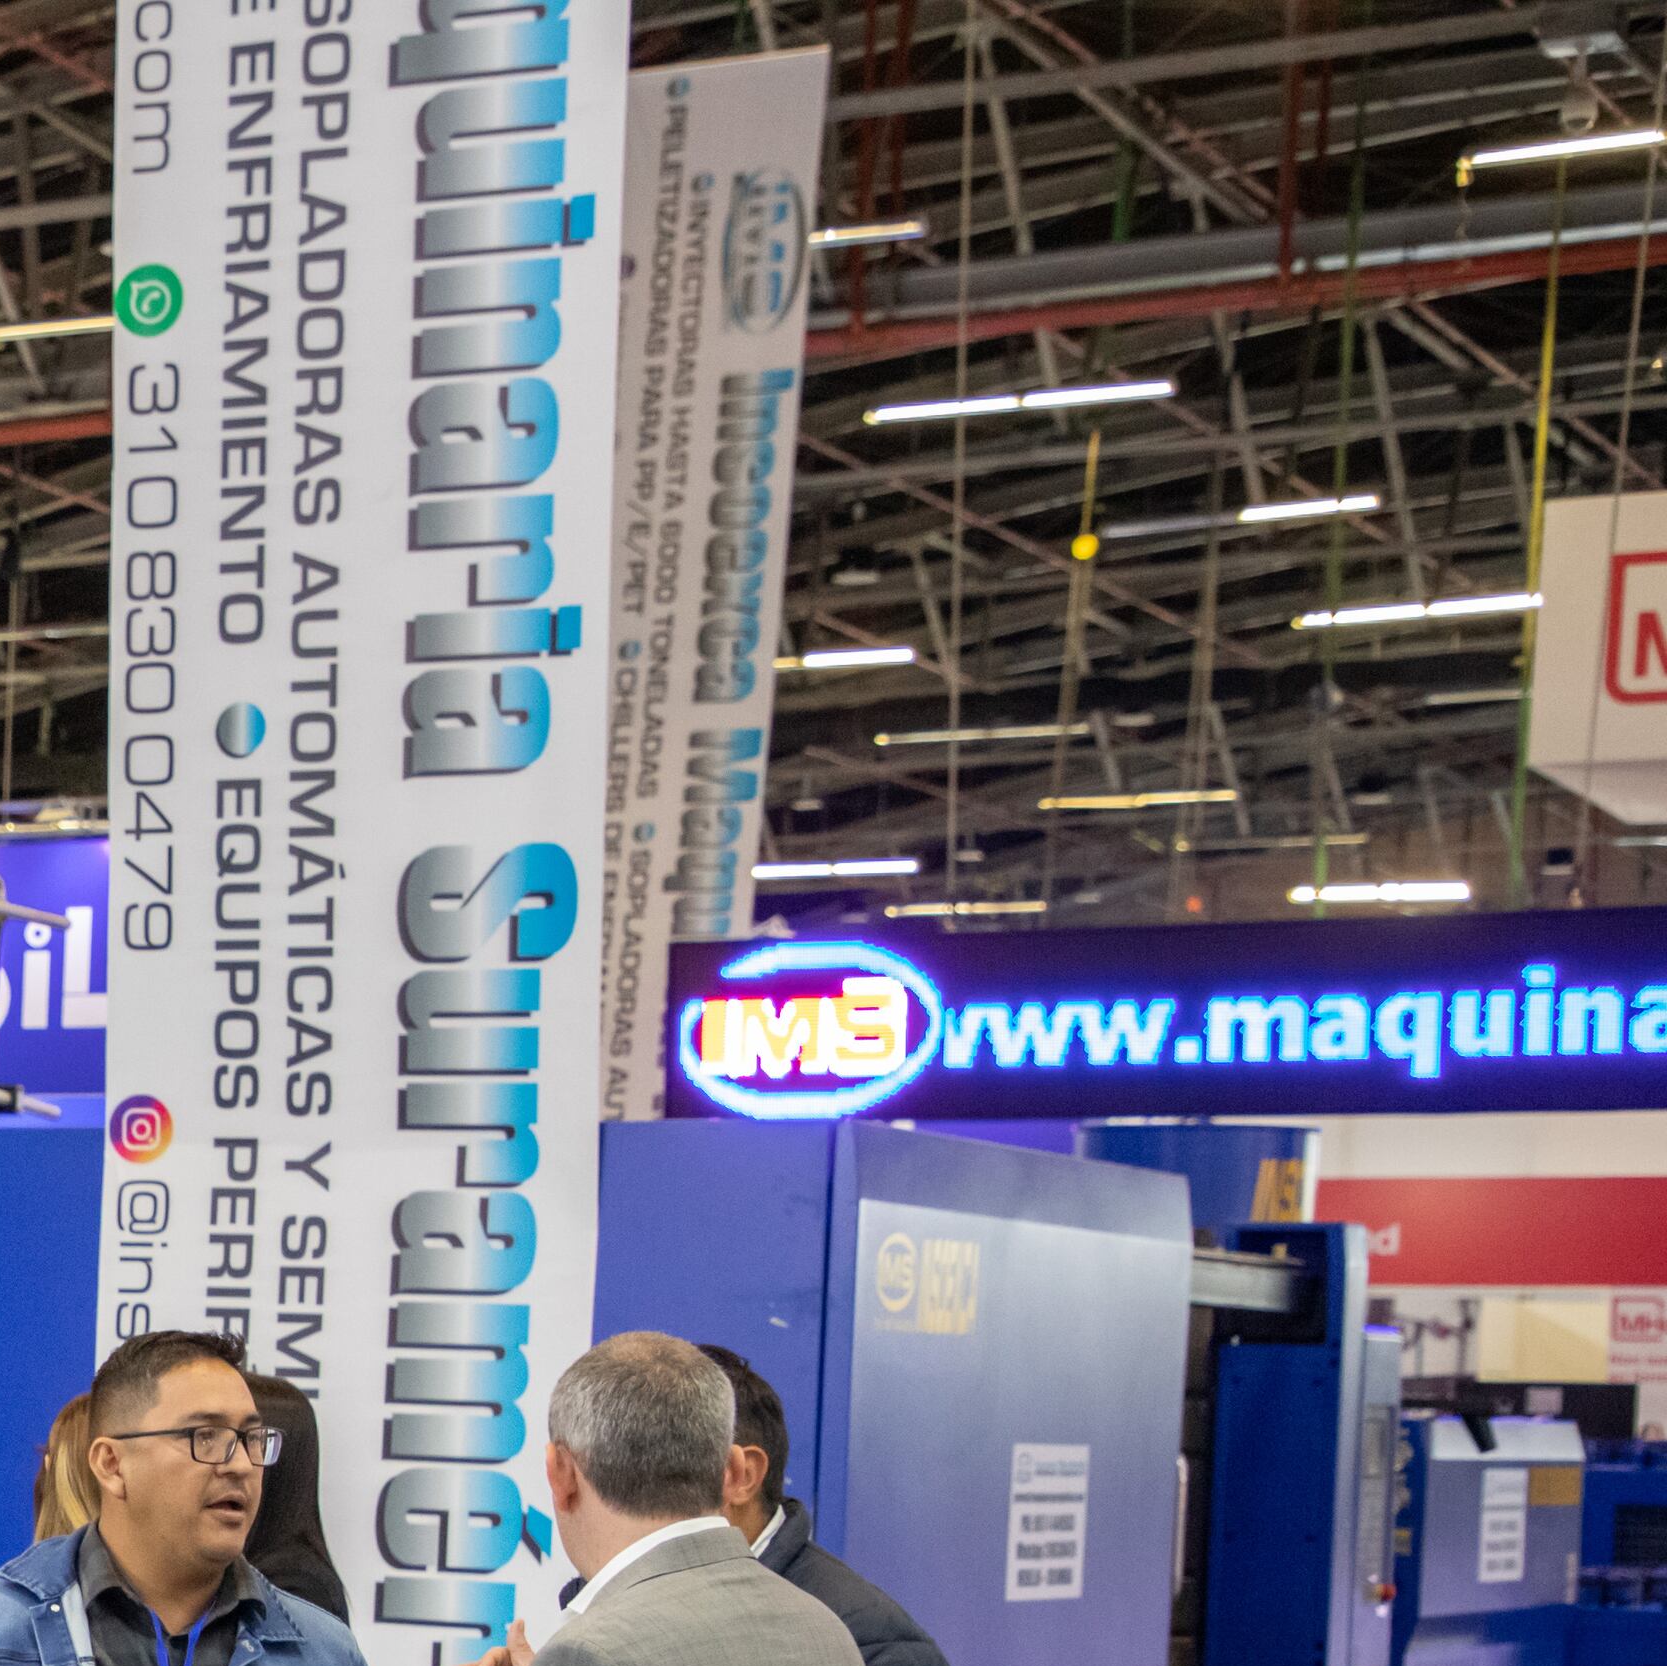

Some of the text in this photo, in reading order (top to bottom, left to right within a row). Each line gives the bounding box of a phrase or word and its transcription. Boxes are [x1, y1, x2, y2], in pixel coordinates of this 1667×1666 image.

[131, 0, 172, 176] com
[217, 40, 276, 645] ENFRIAMIENTO
[292, 0, 351, 527] SOPLADORAS
[671, 198, 712, 398] INYECTORAS
[636, 365, 665, 451] PARA
[664, 406, 693, 512] HASTA
[122, 362, 180, 953] 310 830 0479
[634, 614, 676, 799] TONELADAS
[284, 551, 346, 1119] AUTOMÁTICAS
[213, 779, 265, 1111] EQUIPOS
[611, 849, 653, 1059] SOPLADORAS
[283, 1142, 332, 1192] Y
